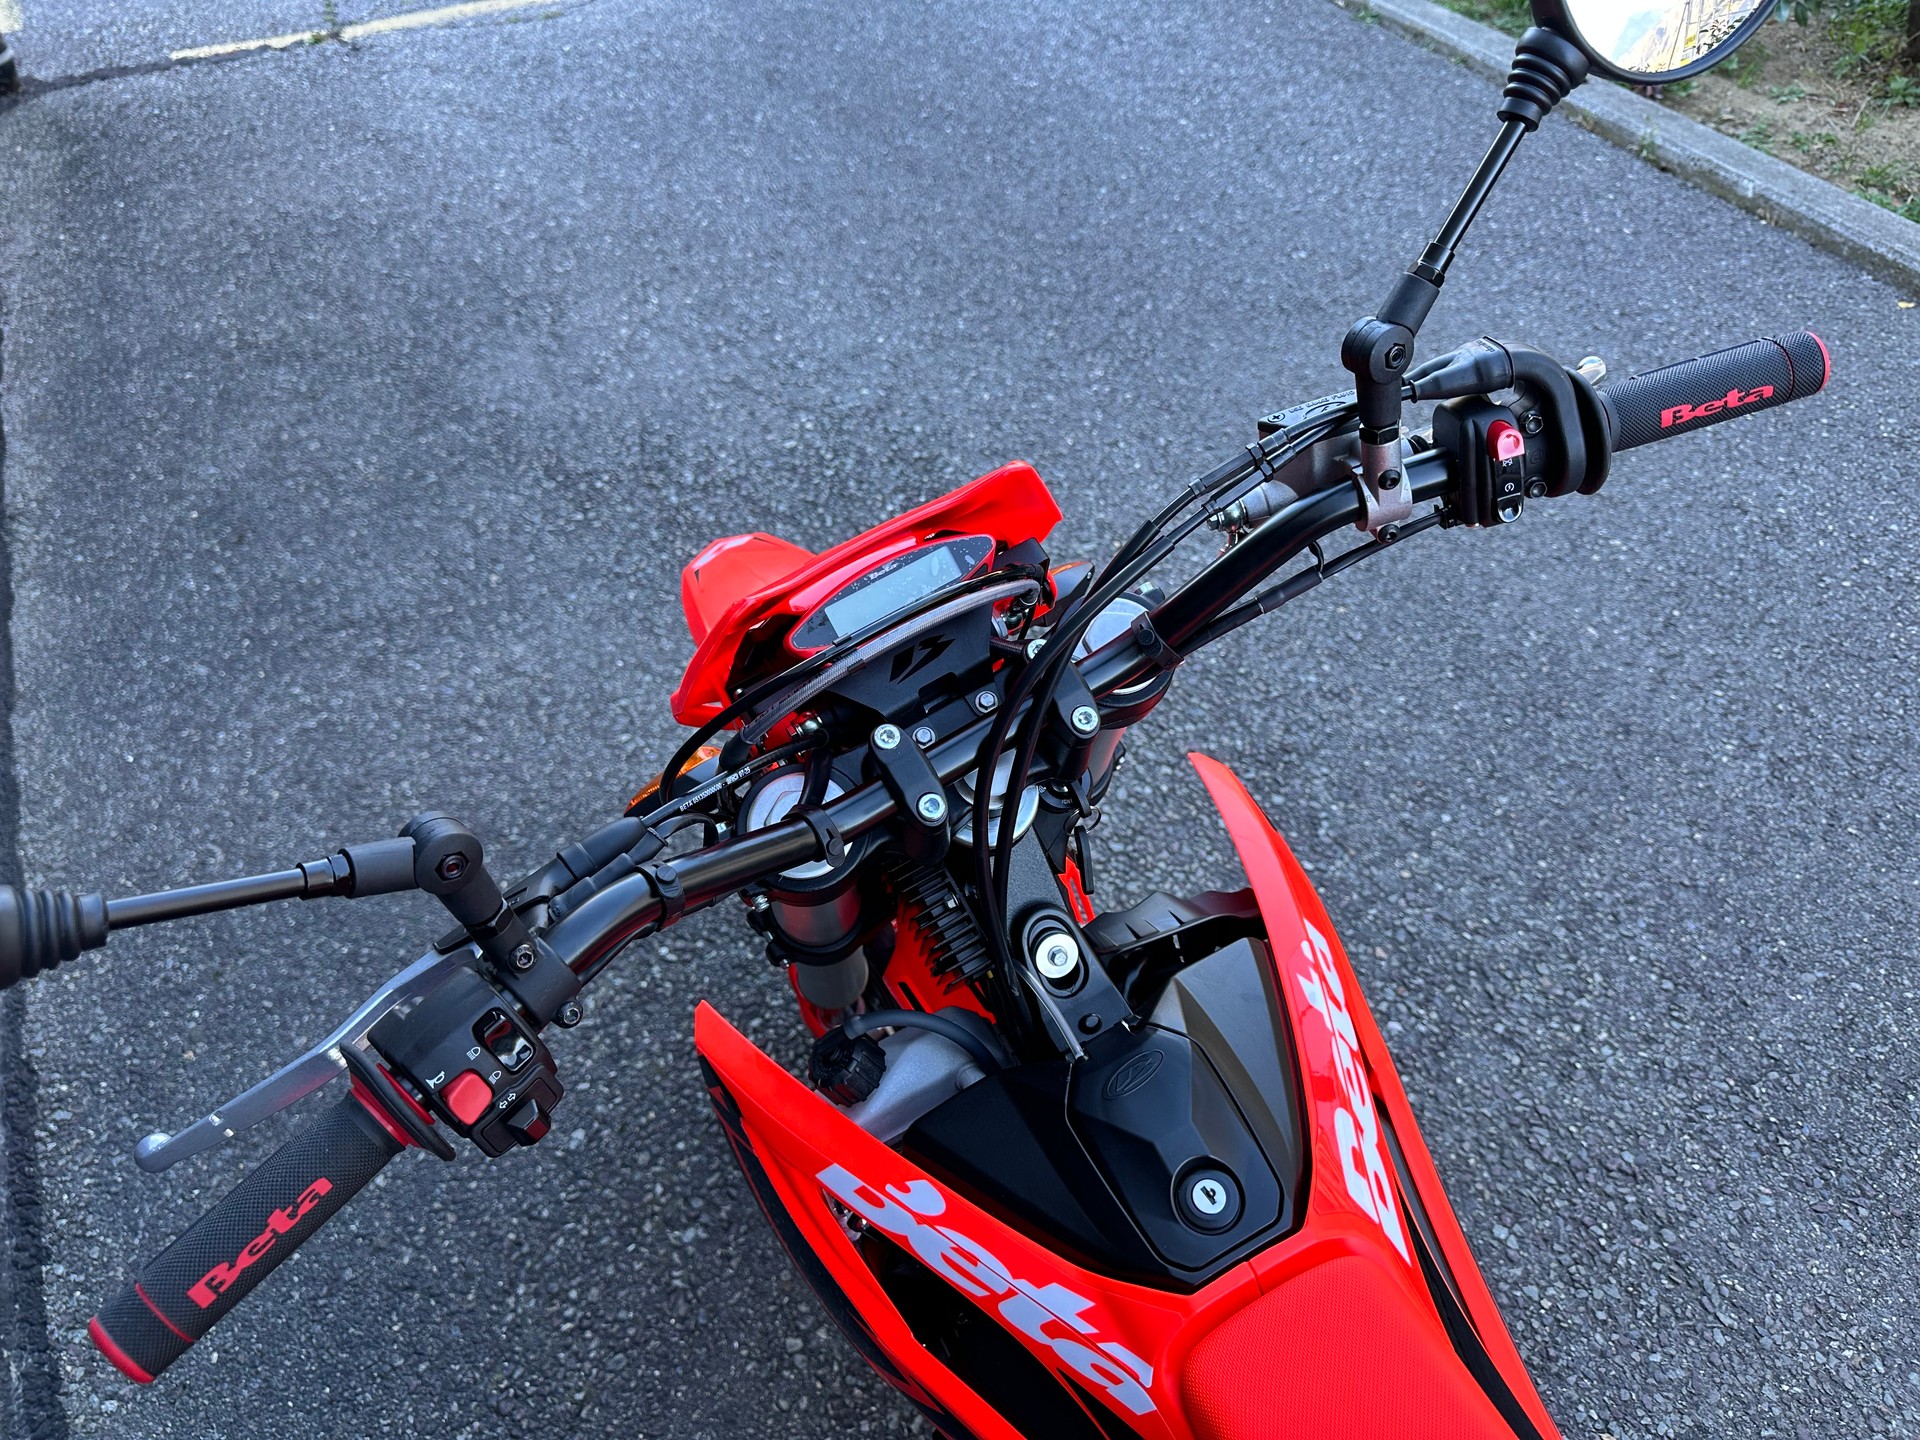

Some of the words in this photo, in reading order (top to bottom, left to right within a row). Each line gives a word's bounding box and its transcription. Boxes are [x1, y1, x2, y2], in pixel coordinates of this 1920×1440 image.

[1661, 385, 1774, 429] Beta
[679, 799, 694, 812] BETA
[1296, 917, 1412, 1268] Beta
[186, 1177, 334, 1309] Beta
[815, 1163, 1158, 1416] Beta
